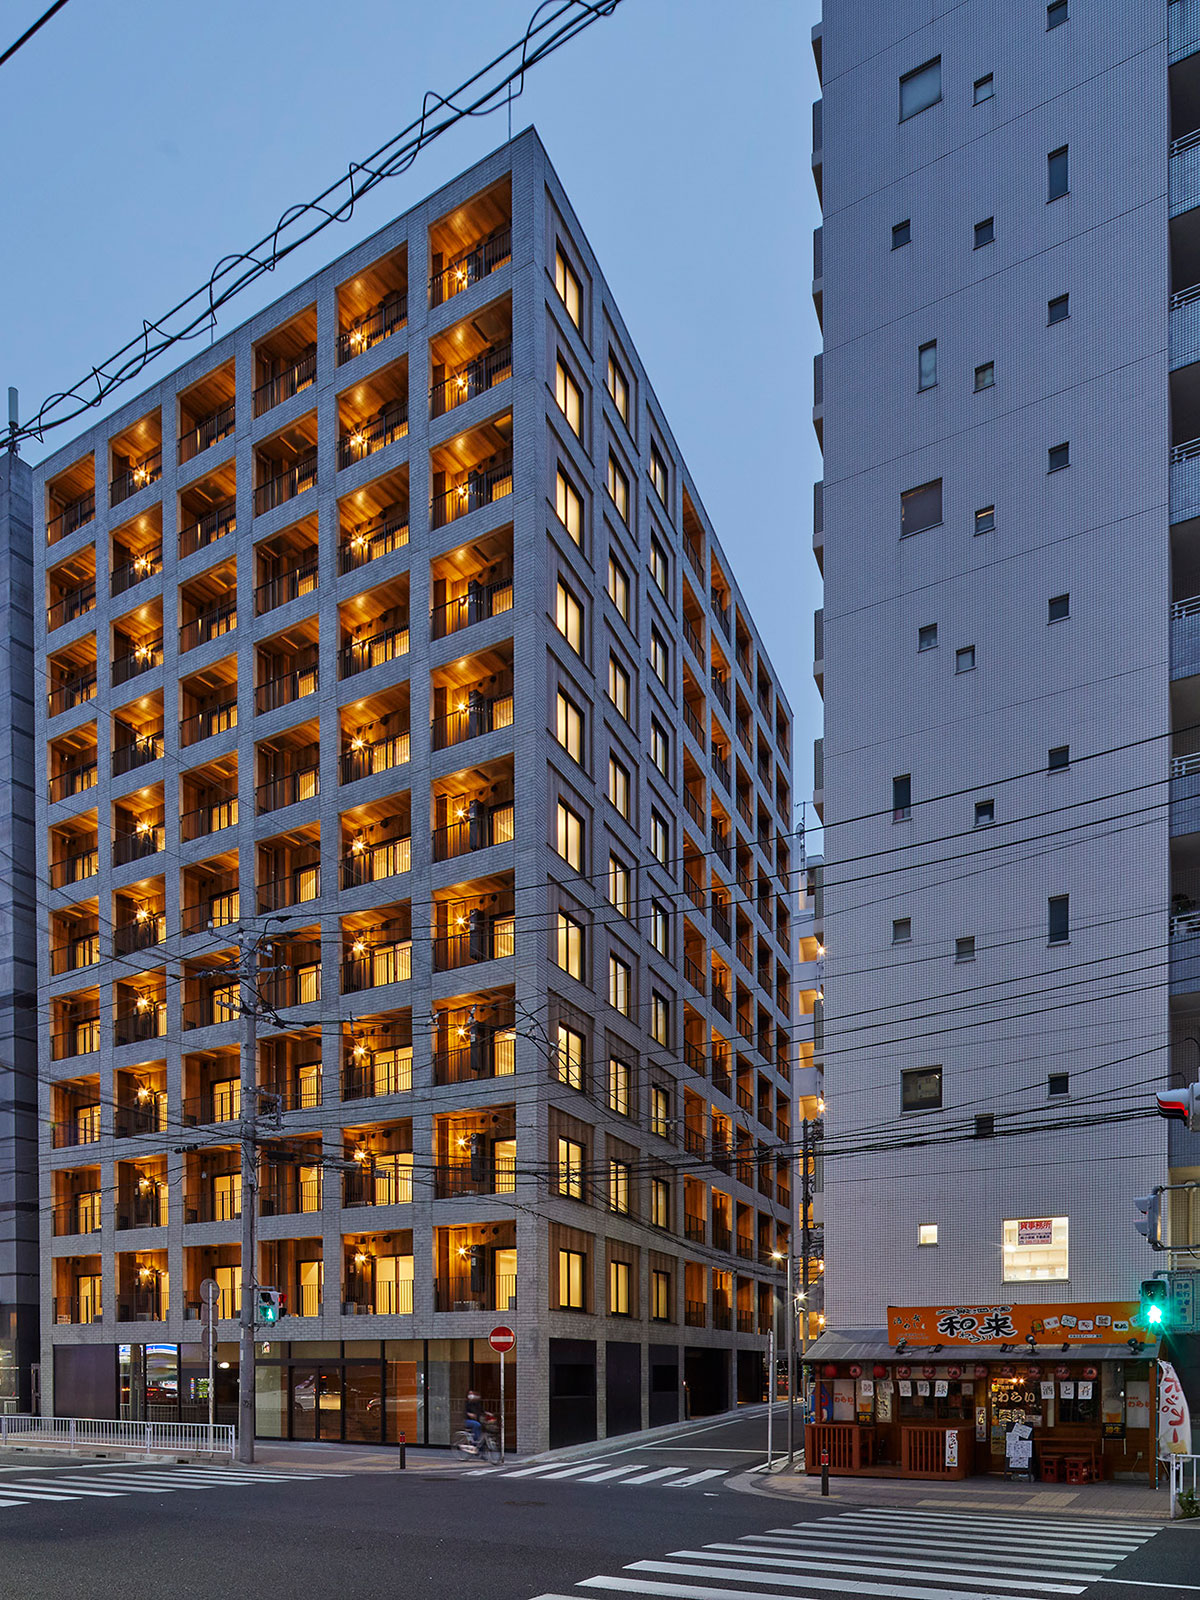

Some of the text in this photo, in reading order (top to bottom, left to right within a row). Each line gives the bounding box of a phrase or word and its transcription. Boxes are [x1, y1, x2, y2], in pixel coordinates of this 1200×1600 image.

[938, 1312, 1018, 1337] 和来
[998, 1391, 1036, 1403] わらい
